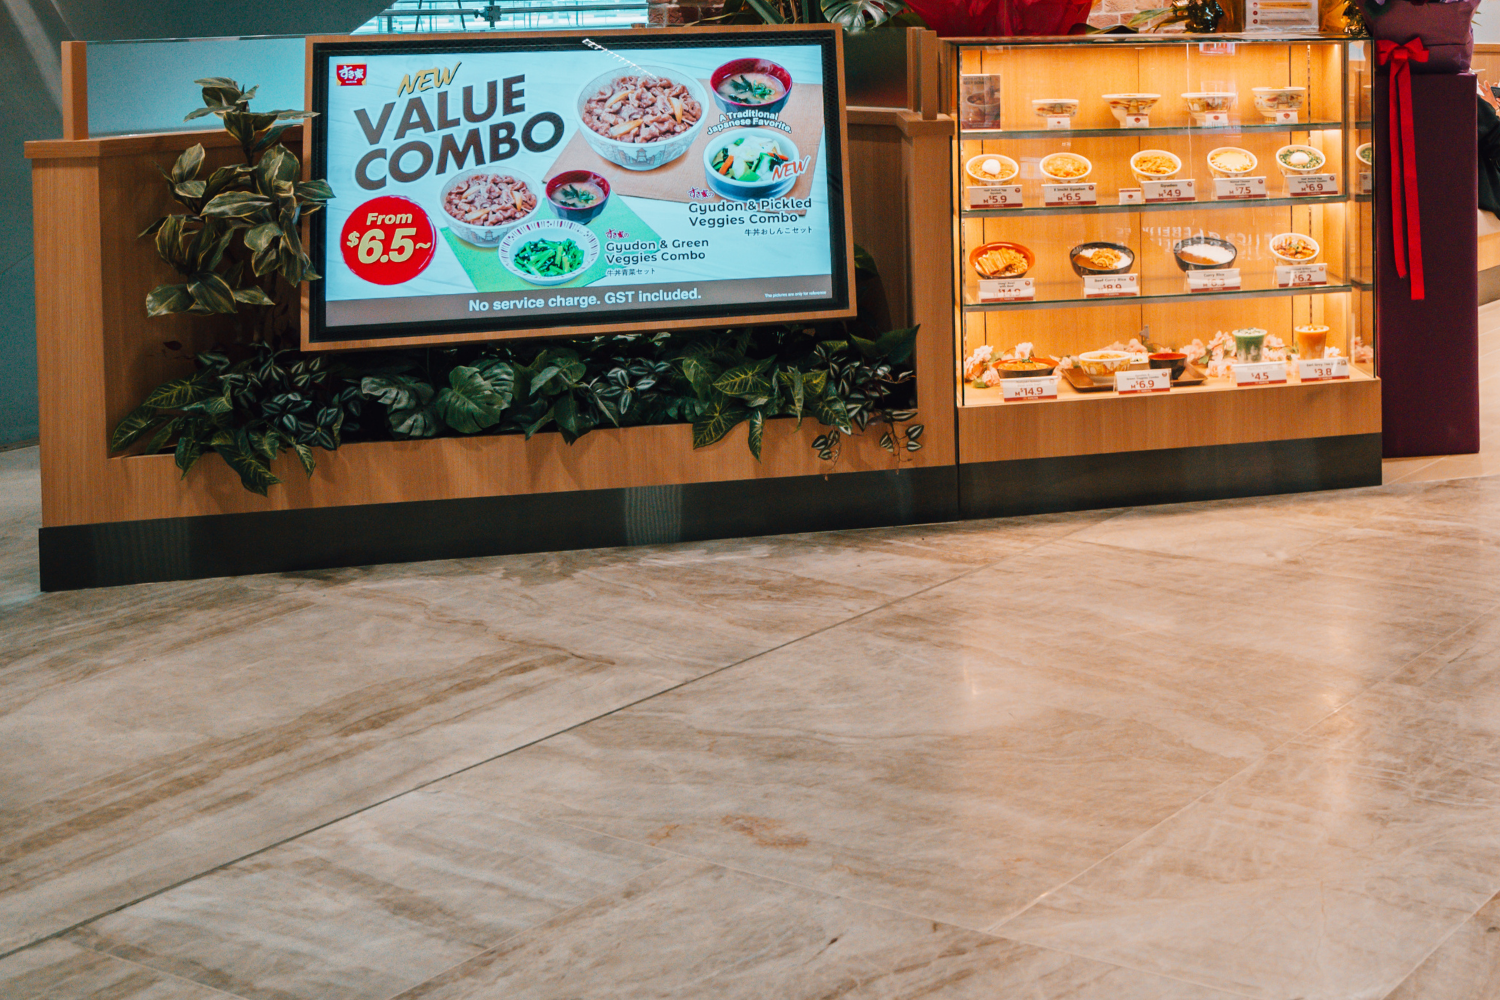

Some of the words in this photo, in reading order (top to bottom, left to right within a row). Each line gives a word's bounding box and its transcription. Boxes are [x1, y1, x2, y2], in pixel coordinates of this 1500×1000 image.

[397, 61, 462, 97] NEW
[354, 74, 526, 145] VALUE
[727, 110, 779, 121] Traditional
[707, 117, 751, 135] Japanese
[752, 117, 792, 134] Favorite.
[355, 111, 565, 191] COMBO
[772, 155, 810, 181] NEW
[689, 202, 743, 215] Gyudon
[747, 201, 756, 210] &
[761, 197, 812, 209] Pickled
[989, 195, 1007, 203] $5.9
[367, 213, 412, 225] From
[689, 213, 745, 228] Veggies
[749, 213, 798, 224] Combo
[606, 241, 656, 253] Gyudon
[660, 240, 668, 249] &
[672, 238, 709, 248] Green
[606, 253, 657, 265] Veggies
[661, 251, 706, 261] Combo
[469, 299, 489, 311] No
[493, 297, 545, 310] service
[549, 293, 600, 309] charge.
[604, 291, 635, 304] GST
[638, 287, 702, 302] included.
[1251, 372, 1269, 380] $4.5
[1020, 387, 1043, 396] $14.9
[1135, 380, 1154, 389] $6.9
